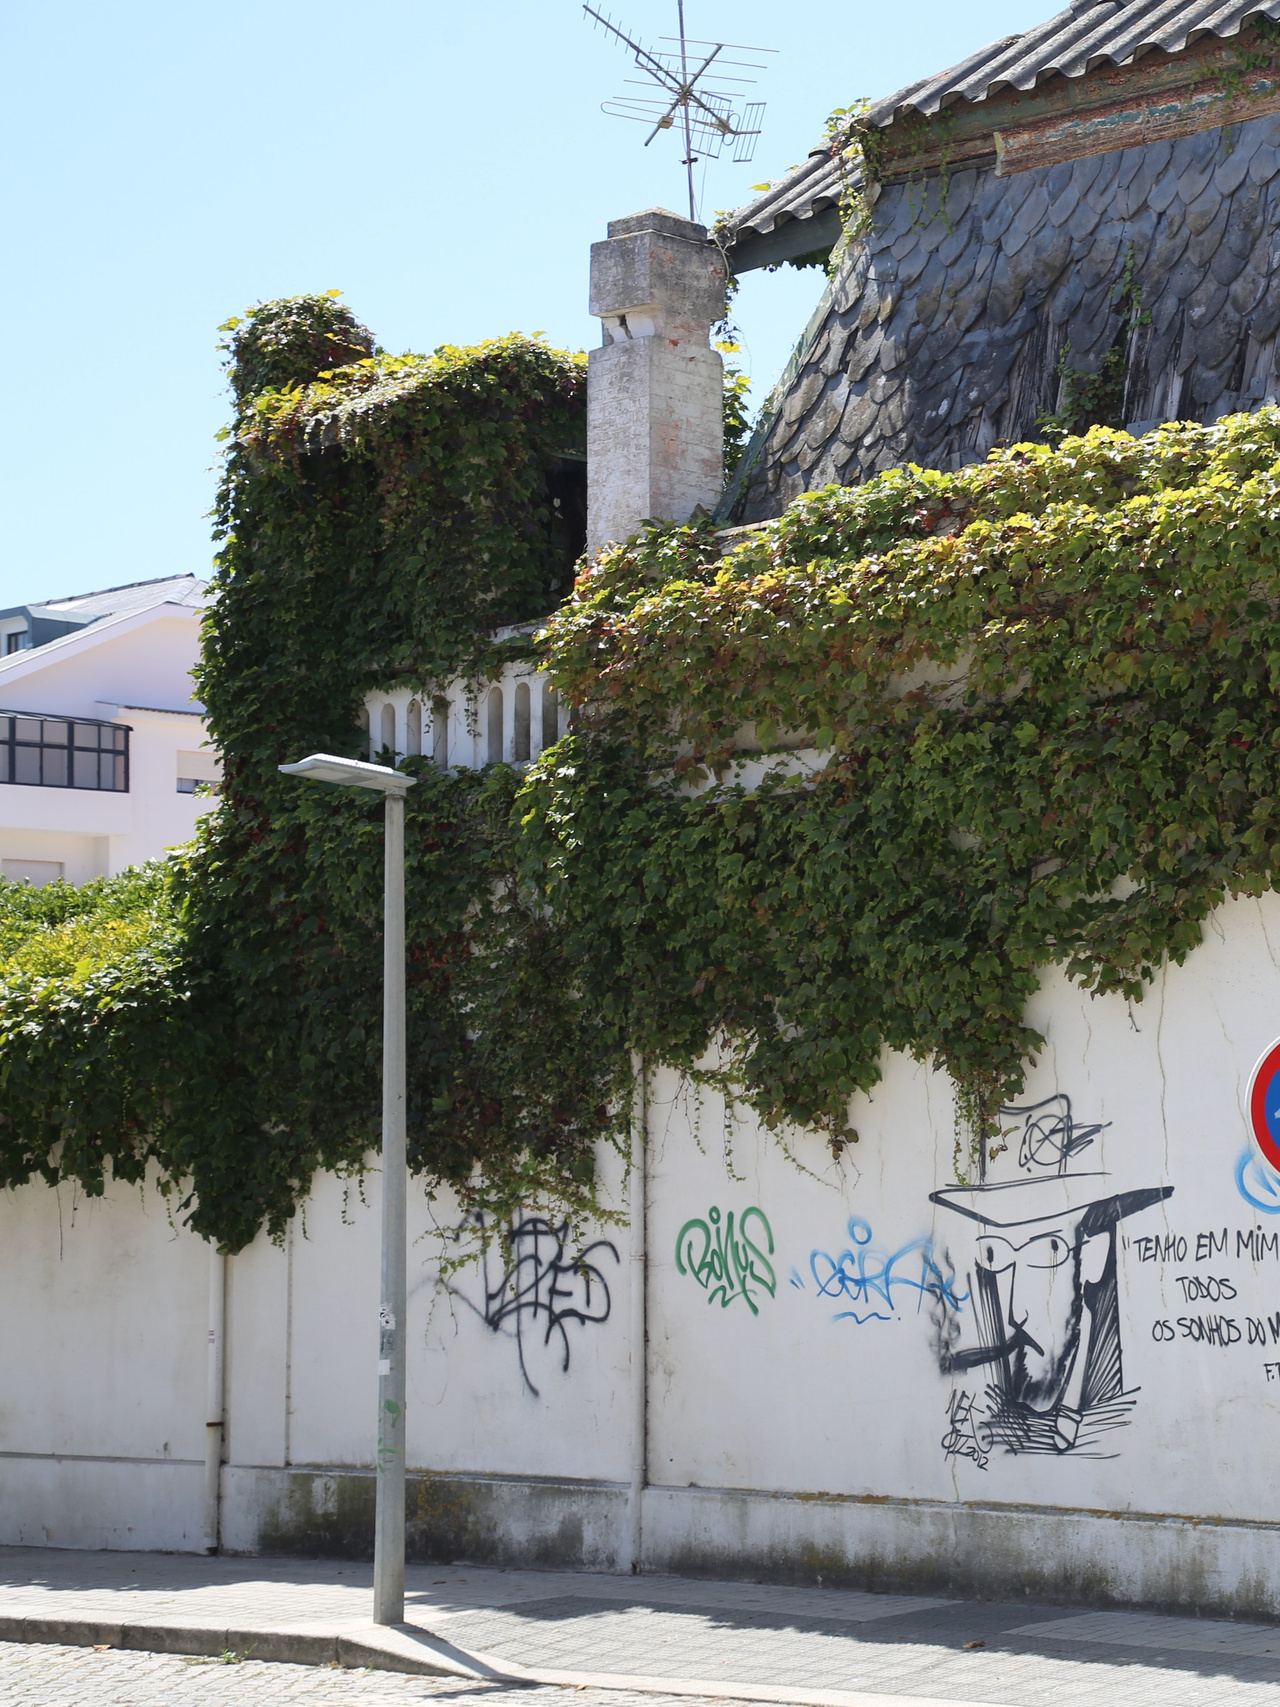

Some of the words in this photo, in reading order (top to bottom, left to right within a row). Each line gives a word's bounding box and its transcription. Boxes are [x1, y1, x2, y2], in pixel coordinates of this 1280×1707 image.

[1195, 1228, 1228, 1262] EM
[1175, 1275, 1237, 1303] TODOS
[1152, 1319, 1175, 1342] OS
[1177, 1314, 1242, 1347] SONHOS
[1245, 1316, 1266, 1347] DO
